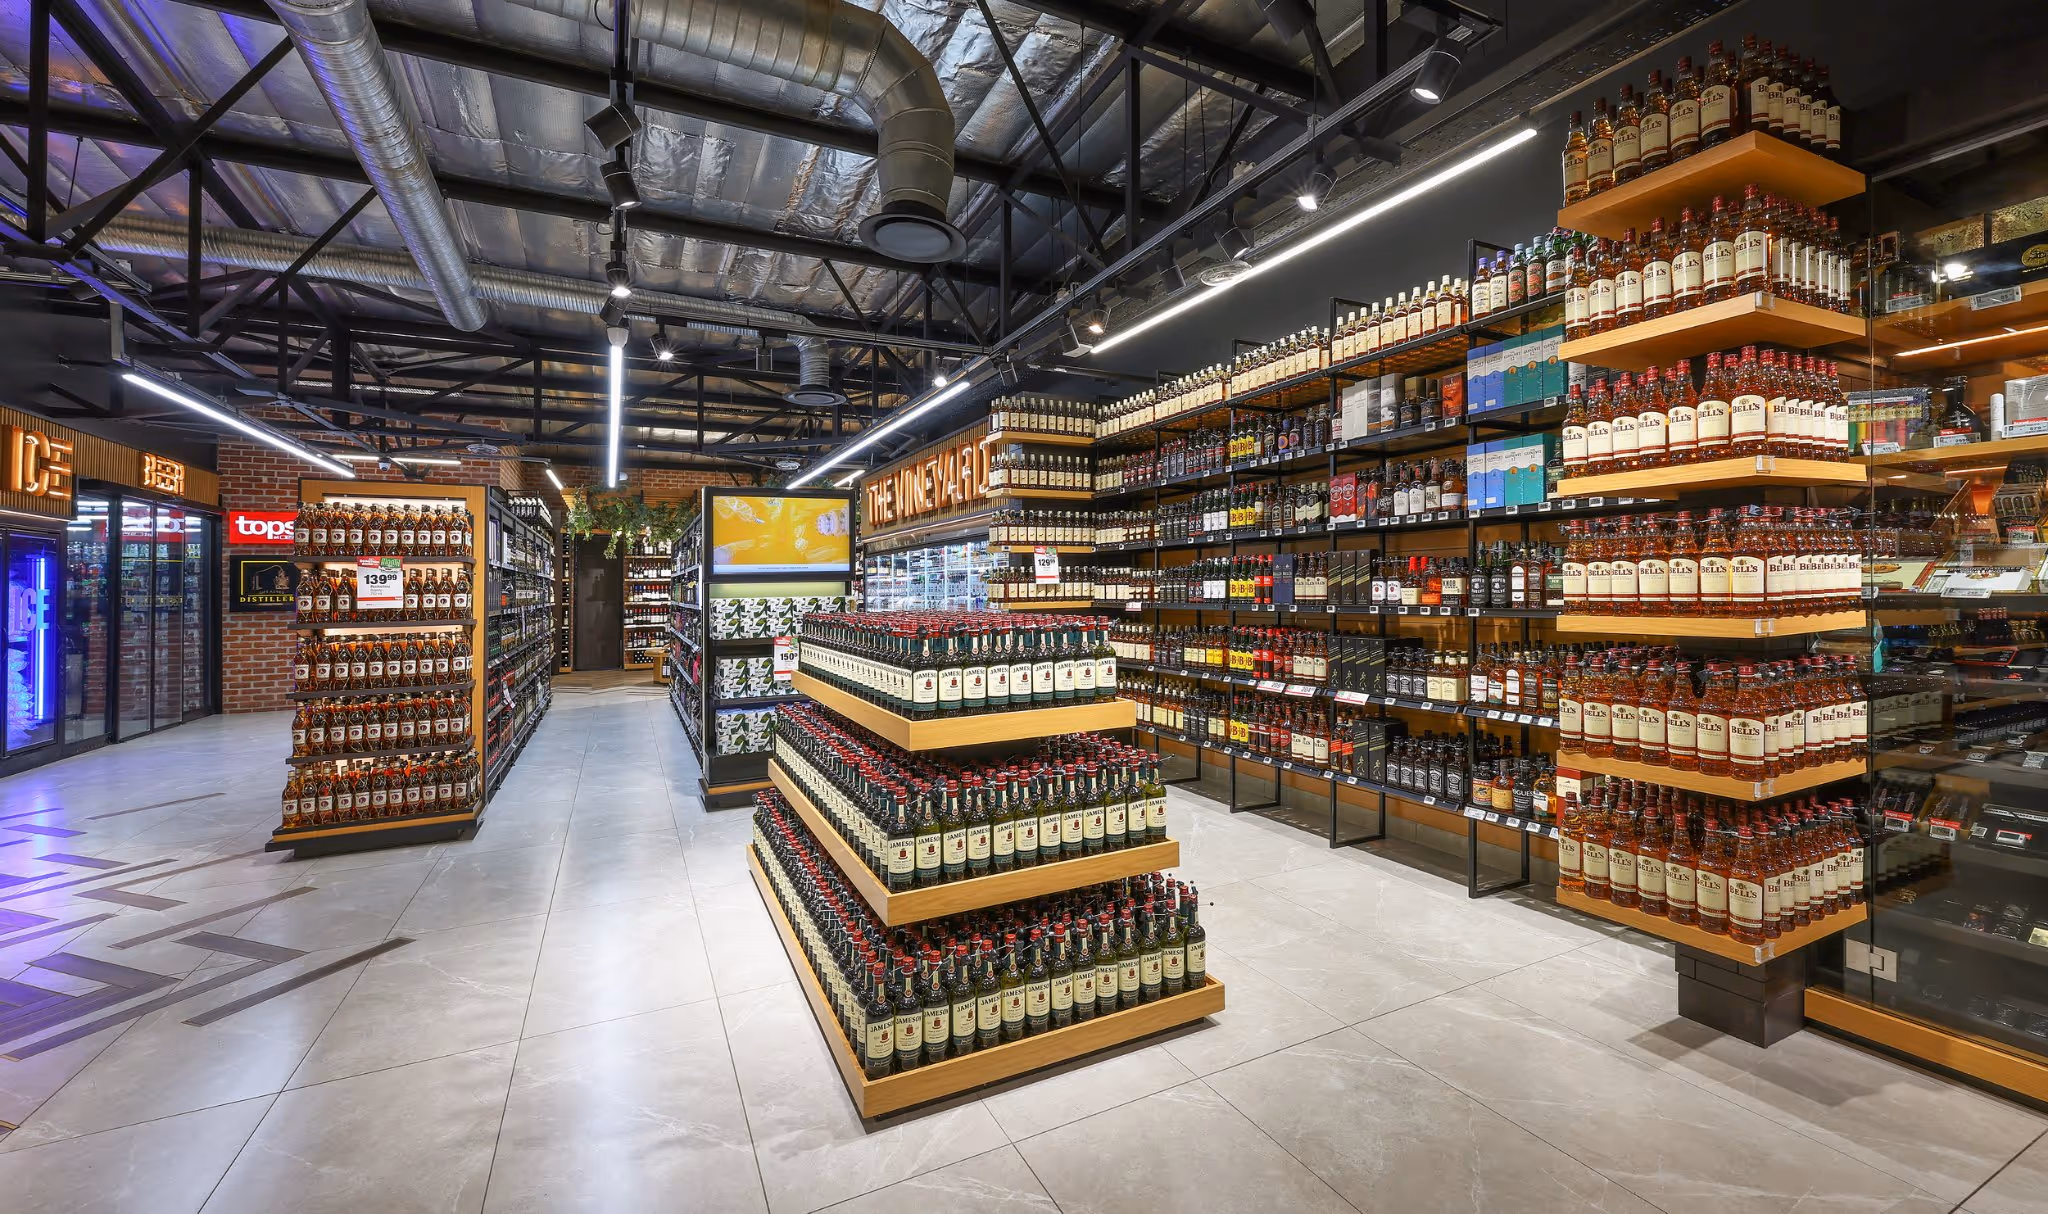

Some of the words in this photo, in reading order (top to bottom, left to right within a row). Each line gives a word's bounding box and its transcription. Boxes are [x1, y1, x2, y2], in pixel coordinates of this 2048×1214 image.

[1588, 145, 1608, 157] ELL'S
[1565, 156, 1584, 168] ELL'S
[1704, 249, 1732, 262] BELL'S
[1673, 258, 1700, 272] BELL'S
[1732, 403, 1760, 414] BELL'S
[2, 424, 73, 501] ICE
[142, 451, 185, 496] BEER
[866, 473, 896, 526] THE
[893, 436, 991, 518] VINEYARD
[1701, 565, 1727, 573] BELL'S
[14, 588, 51, 632] ICE
[1584, 708, 1607, 717] BELL'S
[1612, 711, 1635, 720] BELL'S
[1731, 726, 1760, 736] BELL'S
[1609, 855, 1632, 867] BELL'S
[1730, 885, 1758, 899] BELL'S
